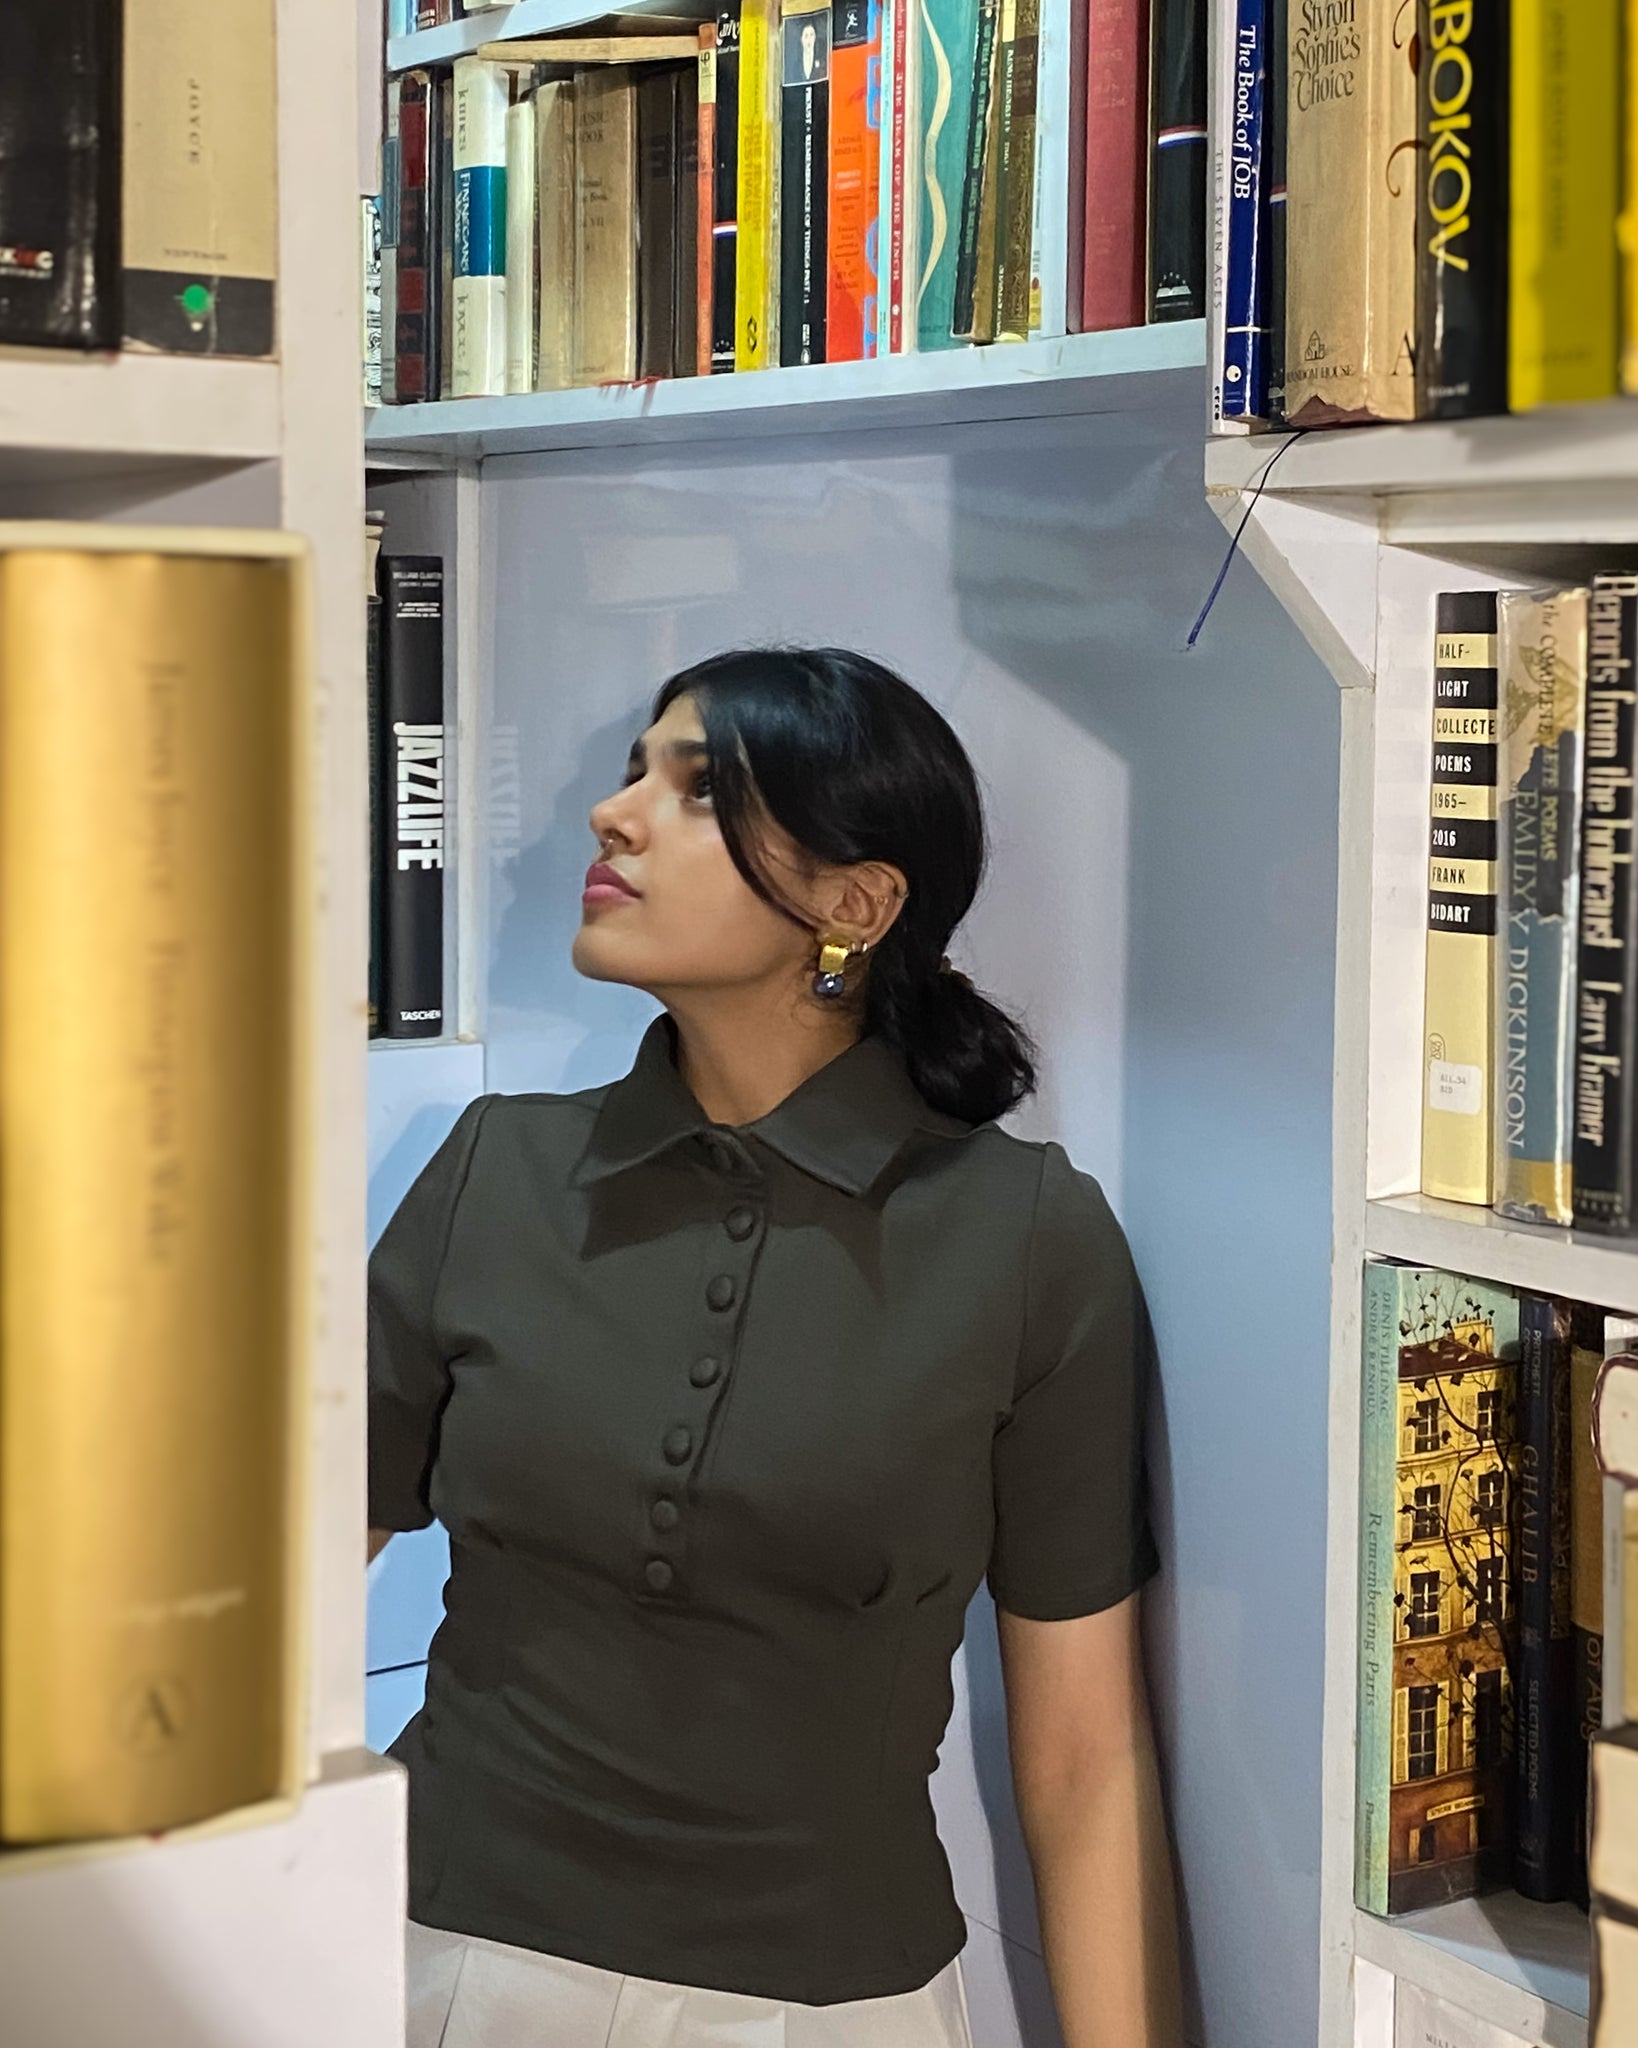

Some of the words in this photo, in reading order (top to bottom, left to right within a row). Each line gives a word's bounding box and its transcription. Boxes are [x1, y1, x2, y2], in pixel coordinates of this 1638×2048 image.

[1298, 0, 1356, 41] Styron
[1239, 25, 1256, 67] The
[1295, 27, 1361, 74] Sophie's
[895, 72, 904, 108] THE
[1236, 71, 1255, 126] Book
[1293, 70, 1354, 112] Choice
[188, 78, 202, 166] JOYCE
[894, 113, 903, 158] BEAK
[1232, 129, 1253, 152] of
[1428, 0, 1473, 271] BOKOV
[804, 134, 812, 213] REMEMBRANCE
[893, 164, 902, 187] OF
[1214, 150, 1224, 183] THE
[1232, 156, 1252, 199] JOB
[460, 172, 471, 272] FINNEGANS
[804, 214, 812, 228] OF
[893, 192, 902, 224] THE
[1214, 196, 1223, 252] SEVEN
[892, 230, 901, 281] FINCH
[803, 269, 811, 293] PAST
[1213, 263, 1223, 309] AGES
[1320, 364, 1355, 379] HOUSE
[1439, 643, 1470, 659] HALF-
[1590, 574, 1638, 682] Reports
[1438, 680, 1469, 697] LIGHT
[1538, 635, 1557, 738] COMPLETE
[1589, 690, 1635, 757] from
[1435, 754, 1472, 773] POEMS
[393, 721, 443, 871] JAZZLIFE
[1587, 765, 1634, 811] the
[1433, 829, 1457, 847] 2016
[1512, 787, 1538, 907] EMILY
[1540, 795, 1558, 862] POEMS
[1432, 867, 1466, 885] FRANK
[1430, 903, 1471, 923] BIDART
[400, 1009, 441, 1021] TASCHEN
[1582, 980, 1623, 1050] Larry
[1505, 946, 1529, 1149] DICKINSON
[1578, 1054, 1621, 1146] Kramer
[1367, 1290, 1379, 1343] ANDRÉ
[1380, 1290, 1392, 1338] DENIS
[1366, 1350, 1378, 1421] RENOUX
[1380, 1343, 1391, 1418] TILLINAC
[1532, 1329, 1542, 1397] PRITCHETT
[1521, 1444, 1539, 1584] GHALIB
[1363, 1511, 1383, 1653] Remembering
[1365, 1660, 1380, 1707] Paris
[1528, 1679, 1539, 1750] SELECTED
[1527, 1751, 1539, 1801] POEMS
